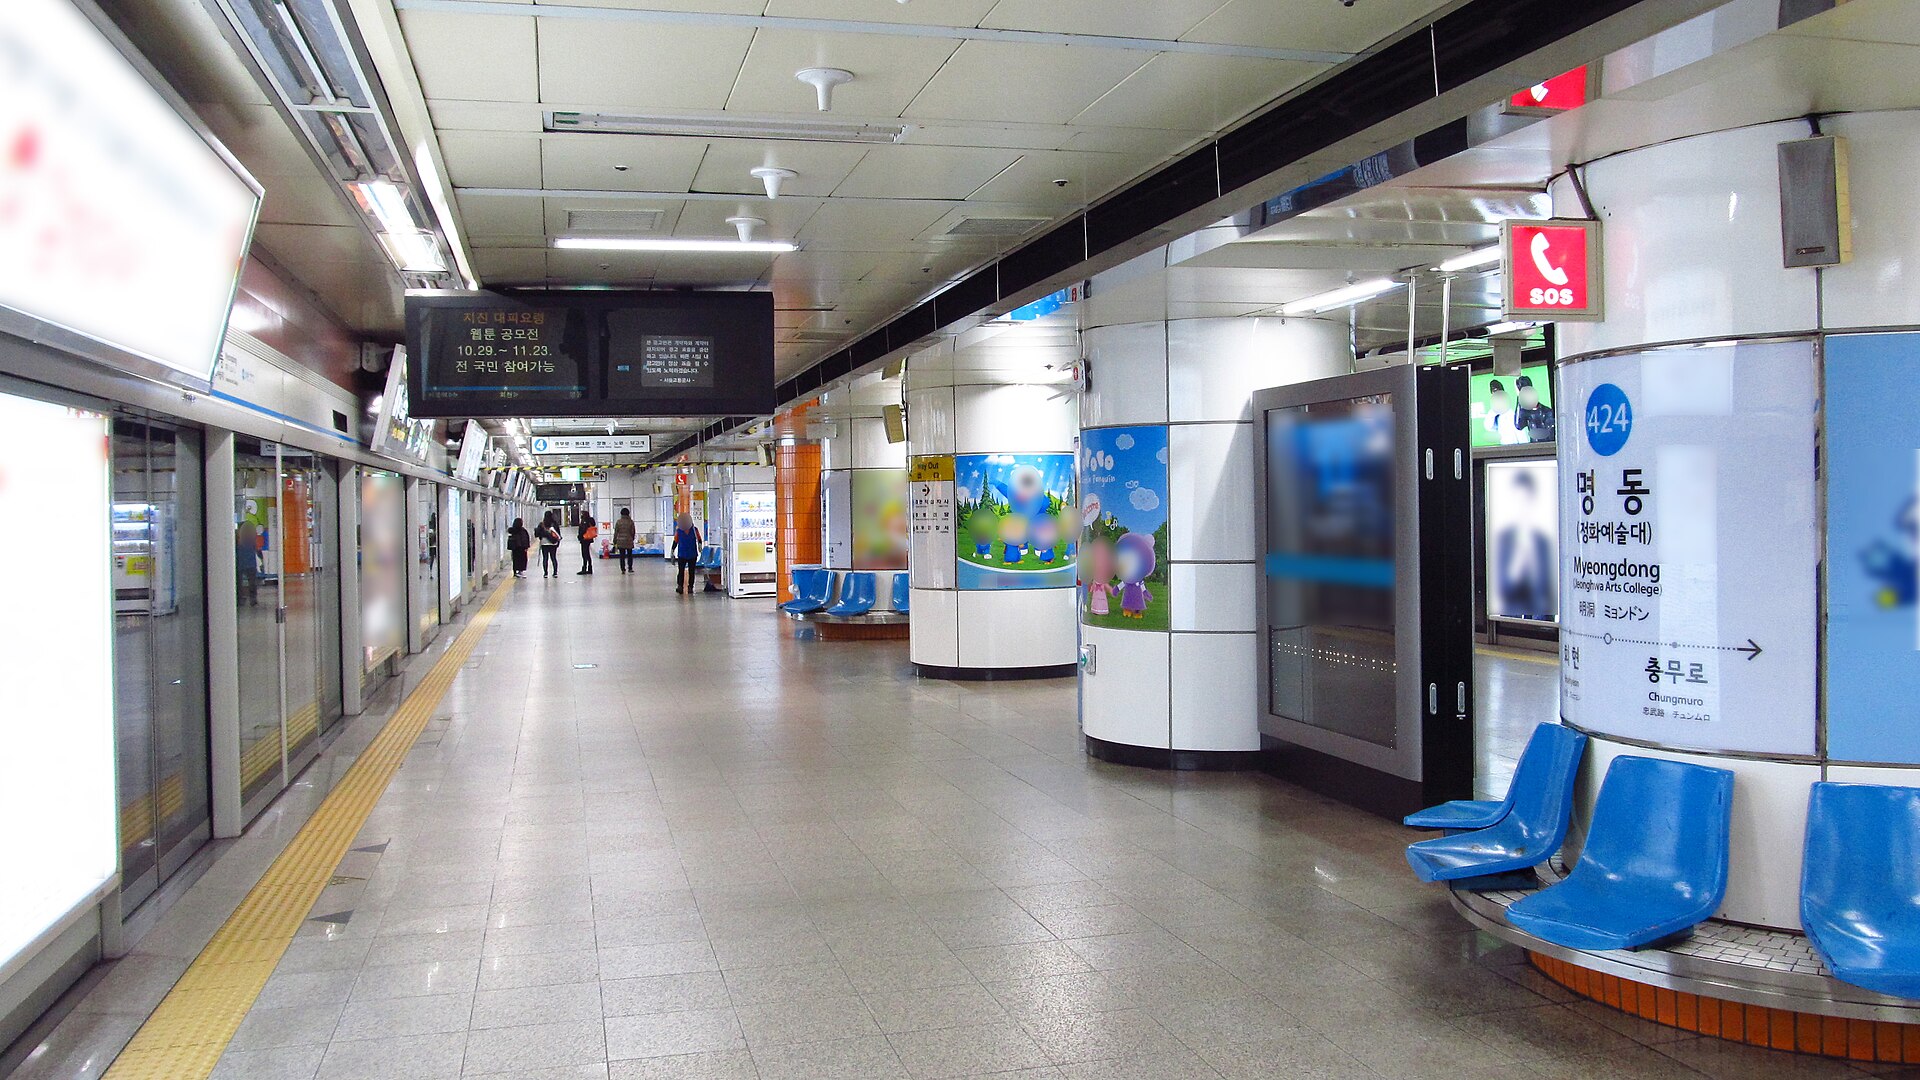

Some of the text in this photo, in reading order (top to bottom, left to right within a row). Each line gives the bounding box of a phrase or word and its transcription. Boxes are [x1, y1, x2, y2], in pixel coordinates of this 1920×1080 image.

[1530, 288, 1574, 305] SOS
[463, 312, 545, 325] 지진 대피요령
[470, 328, 539, 341] 웹툰 공모전
[514, 345, 553, 357] 11.23.
[455, 360, 555, 374] 전 국민 참여가능
[1587, 402, 1629, 434] 424
[536, 439, 545, 451] 4
[927, 462, 939, 470] Out
[1577, 521, 1652, 545] (정화예술대)
[1573, 556, 1660, 583] Myeongdong
[1605, 581, 1622, 593] Arts
[1623, 582, 1663, 598] College)
[1604, 604, 1650, 621] ミョンドン
[1644, 656, 1709, 685] 충무로
[1648, 691, 1704, 707] Chungmuro
[1672, 710, 1711, 722] チュンムロ
